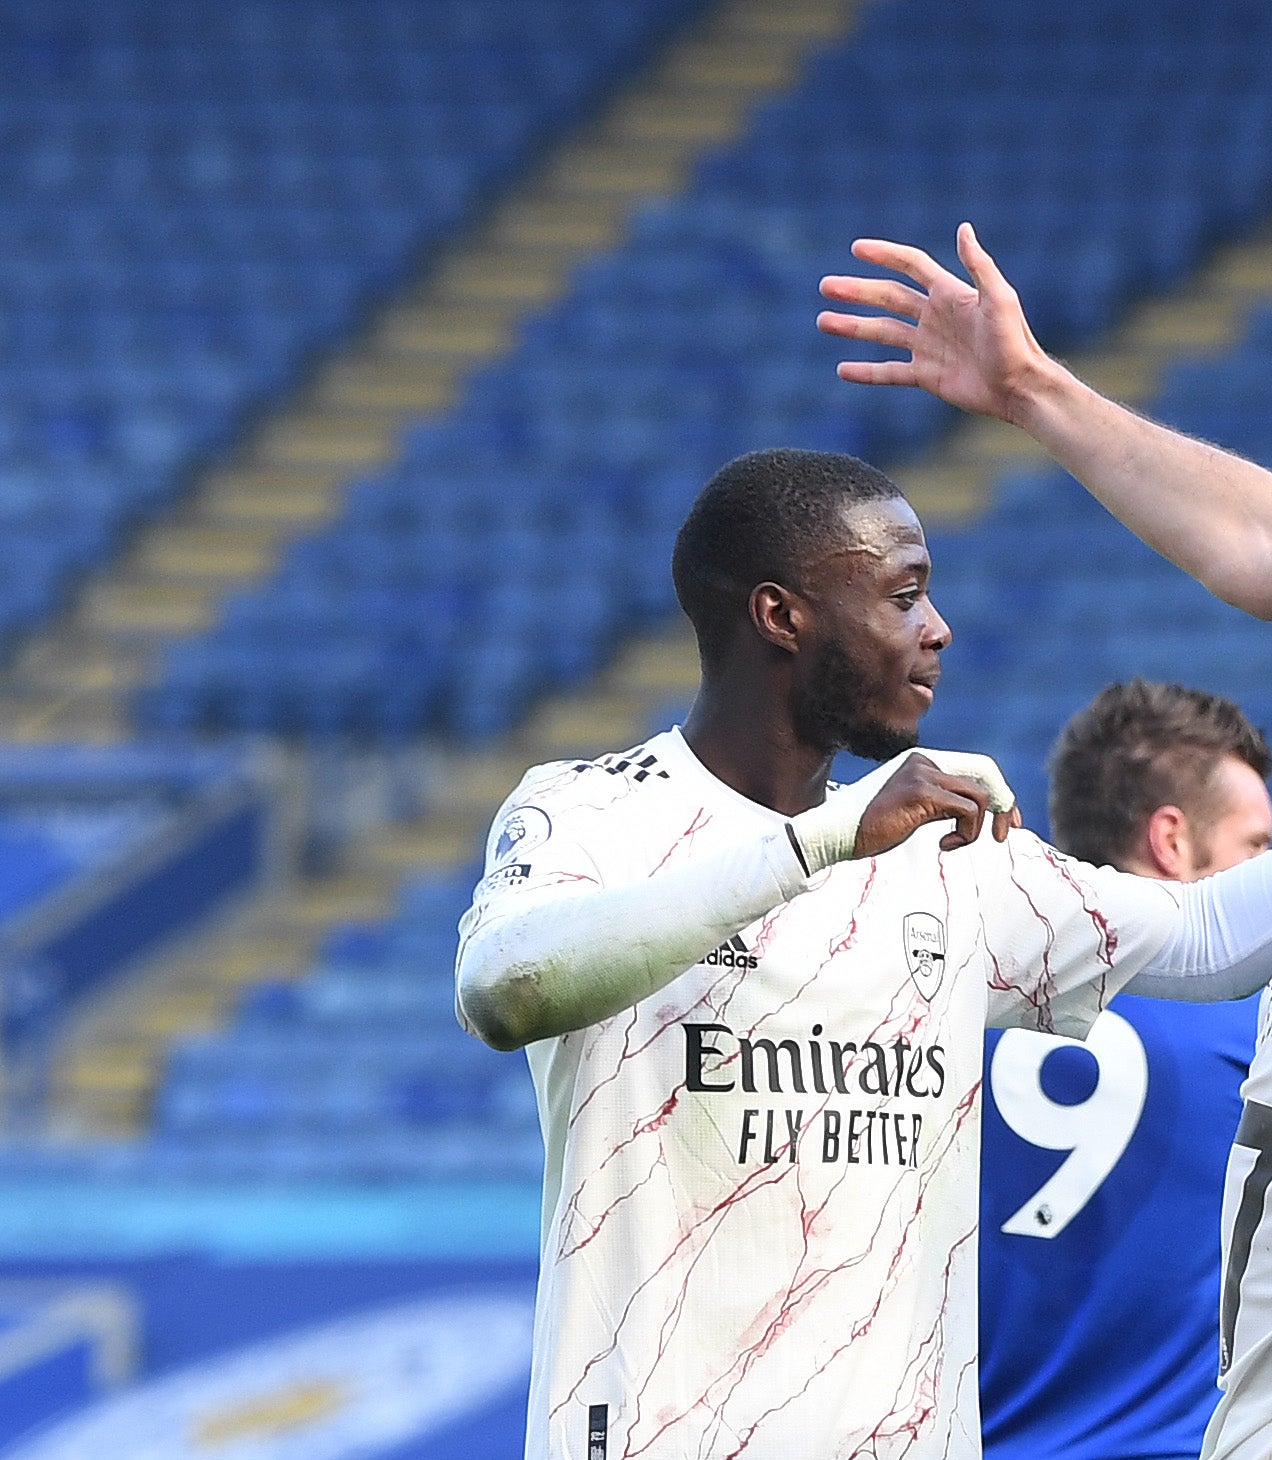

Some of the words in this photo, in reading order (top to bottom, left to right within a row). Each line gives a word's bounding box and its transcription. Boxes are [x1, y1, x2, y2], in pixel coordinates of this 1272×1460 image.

[697, 949, 758, 969] didas
[682, 1023, 945, 1098] Emirates
[738, 1109, 804, 1164] FLY
[822, 1110, 923, 1168] BETTER
[991, 1008, 1149, 1240] 9
